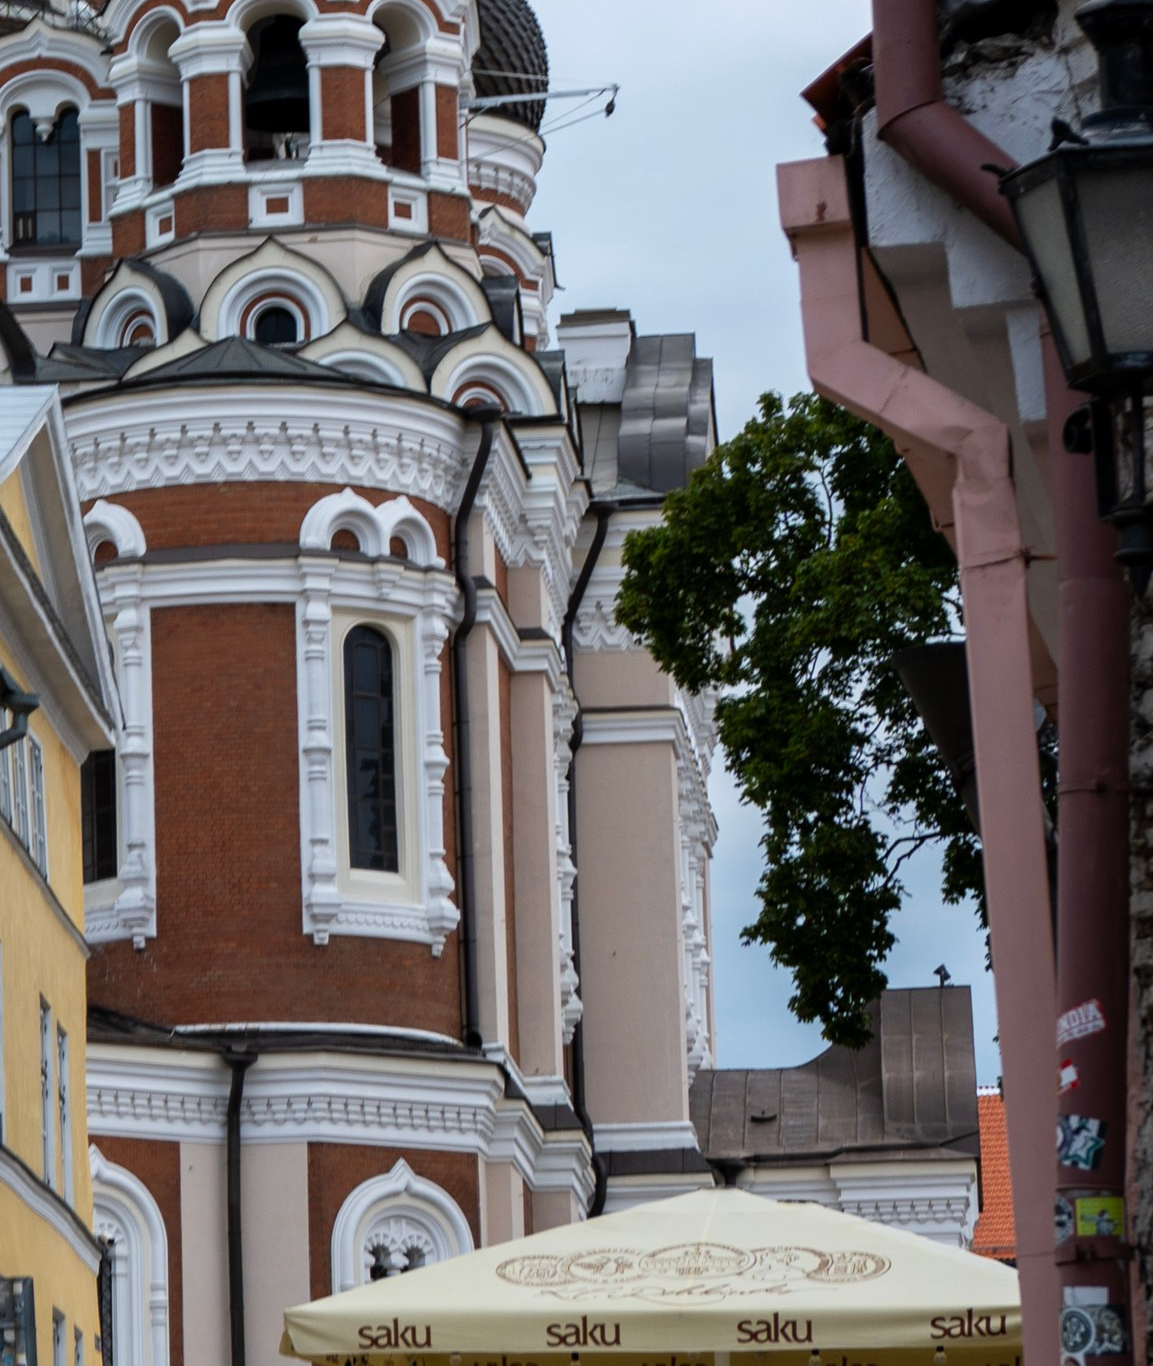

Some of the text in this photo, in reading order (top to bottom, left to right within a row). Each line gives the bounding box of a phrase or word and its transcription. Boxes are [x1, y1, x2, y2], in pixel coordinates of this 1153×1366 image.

[358, 1316, 433, 1350] saku
[545, 1315, 622, 1348] saku
[737, 1311, 814, 1345] saku
[929, 1307, 1008, 1341] saku
